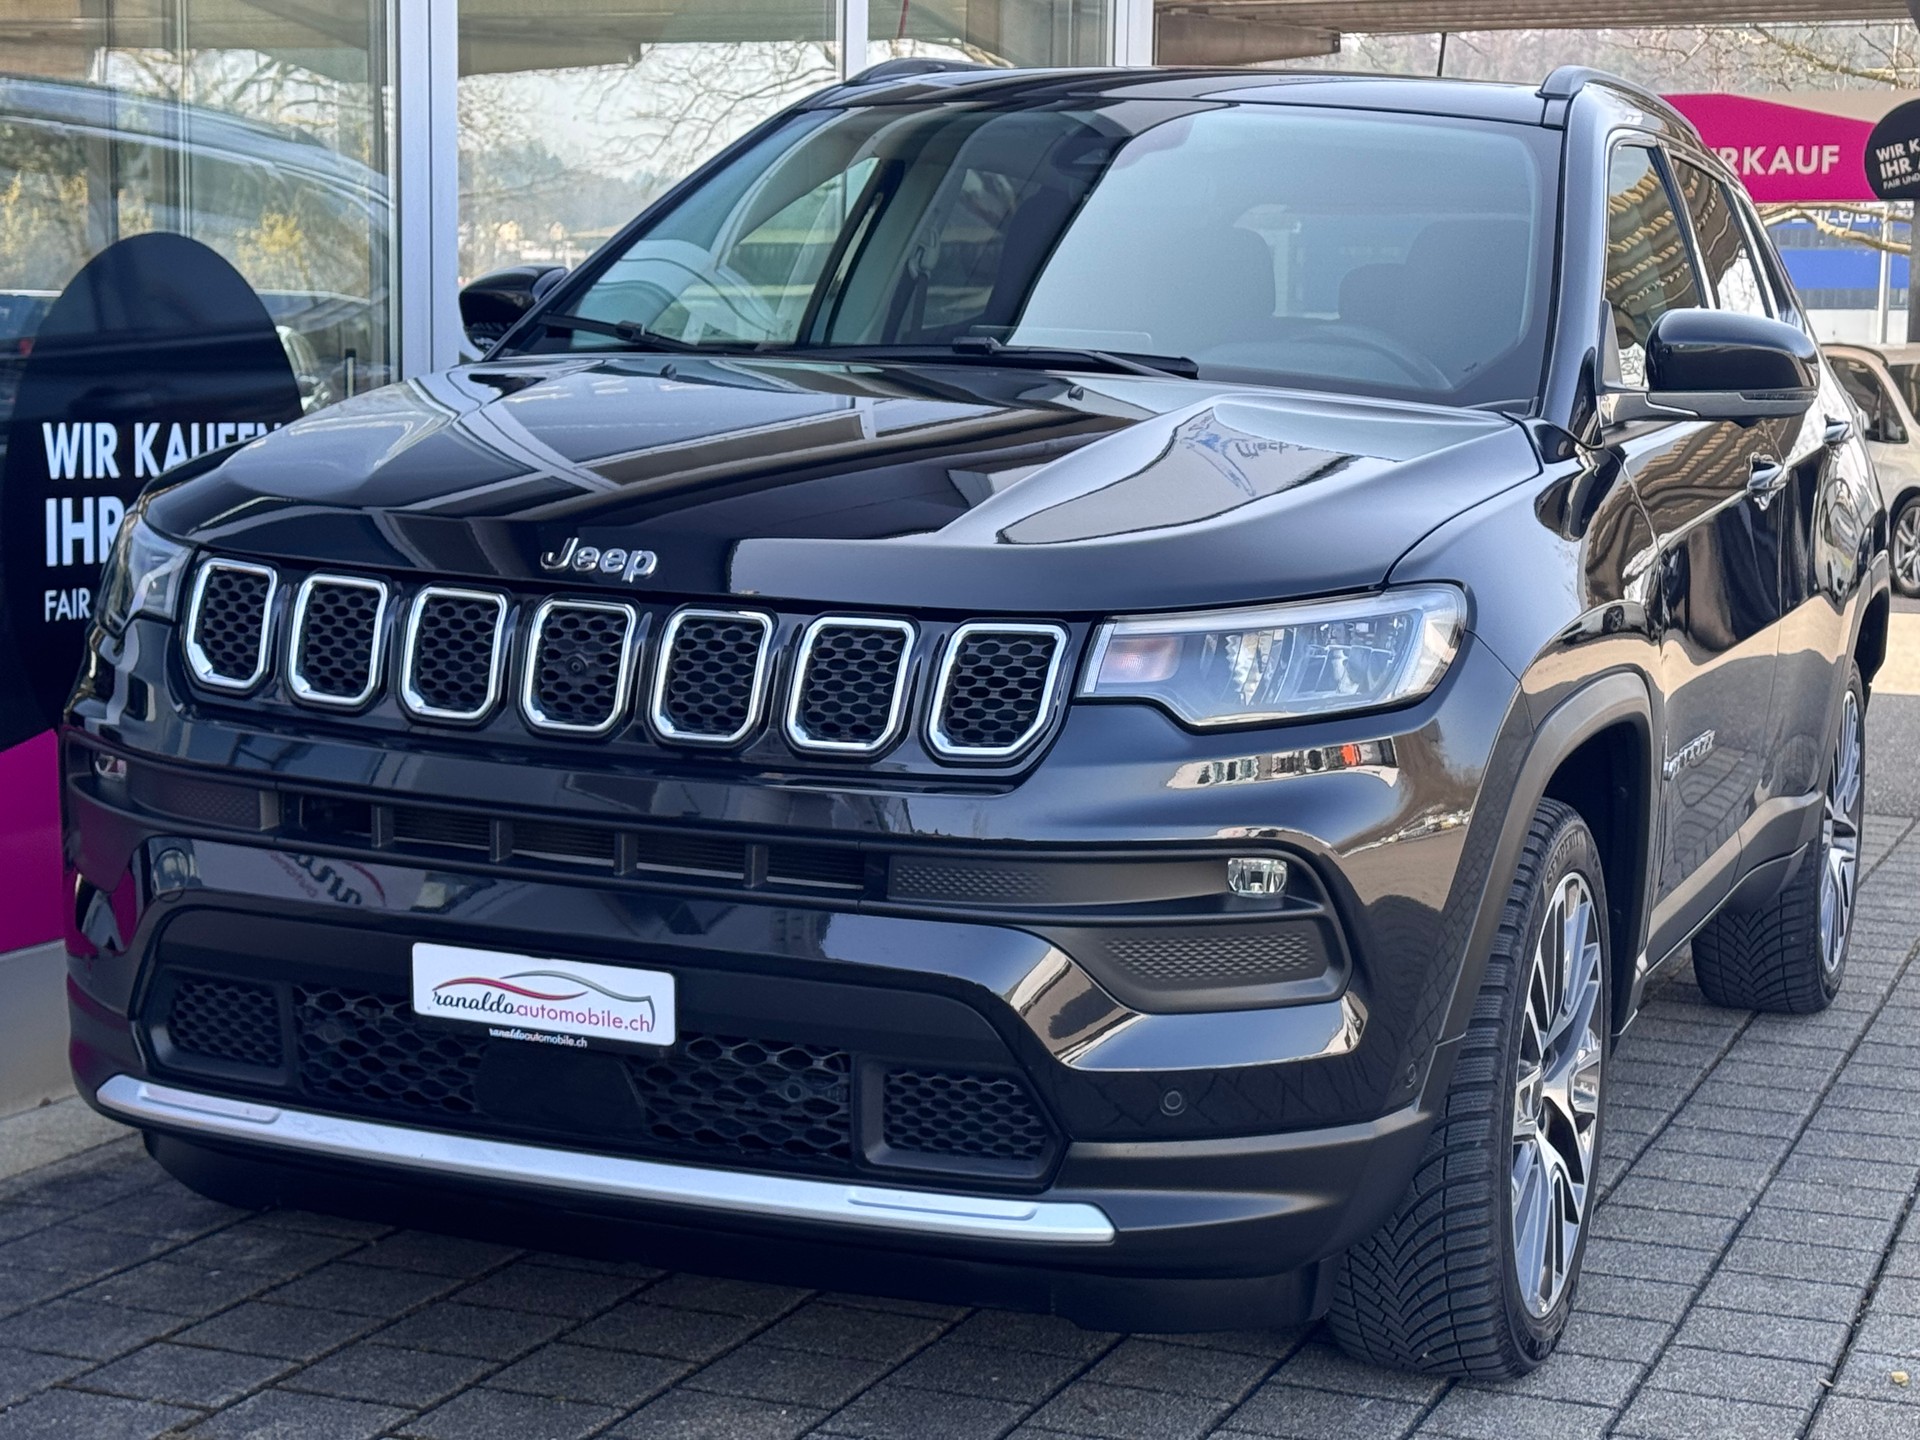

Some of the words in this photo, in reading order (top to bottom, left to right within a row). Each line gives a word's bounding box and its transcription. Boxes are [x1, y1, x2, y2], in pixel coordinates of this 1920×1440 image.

[1711, 145, 1840, 175] RKAUF
[1876, 143, 1906, 162] WIR
[1880, 157, 1912, 179] IHR
[42, 422, 120, 480] WIR
[46, 496, 124, 567] IHR
[540, 537, 657, 582] Jeep
[44, 587, 91, 622] FAIR
[432, 990, 650, 1033] ranaldoautomobile.ch
[488, 1027, 588, 1048] ranaldoautomobile.ch
